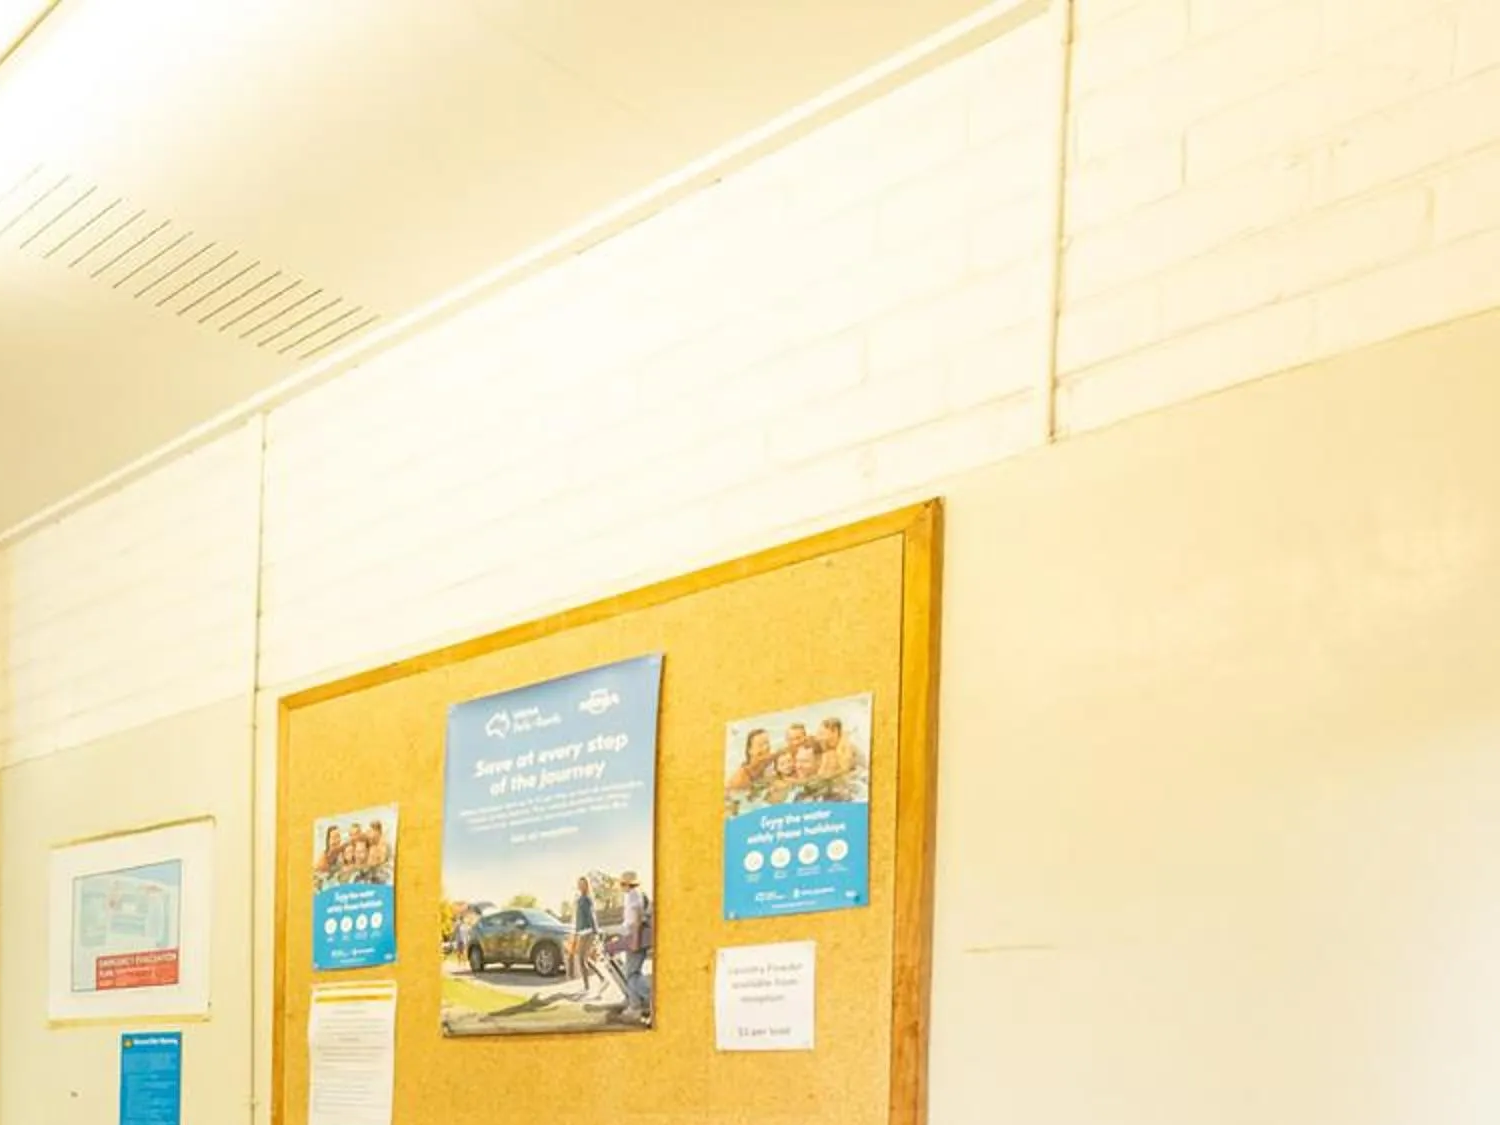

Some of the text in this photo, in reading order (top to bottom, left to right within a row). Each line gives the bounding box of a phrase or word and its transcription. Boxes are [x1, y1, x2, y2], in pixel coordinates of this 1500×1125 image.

[474, 731, 629, 778] Save at every step
[489, 760, 606, 796] of the journey
[784, 812, 801, 824] the
[803, 821, 846, 836] holidays
